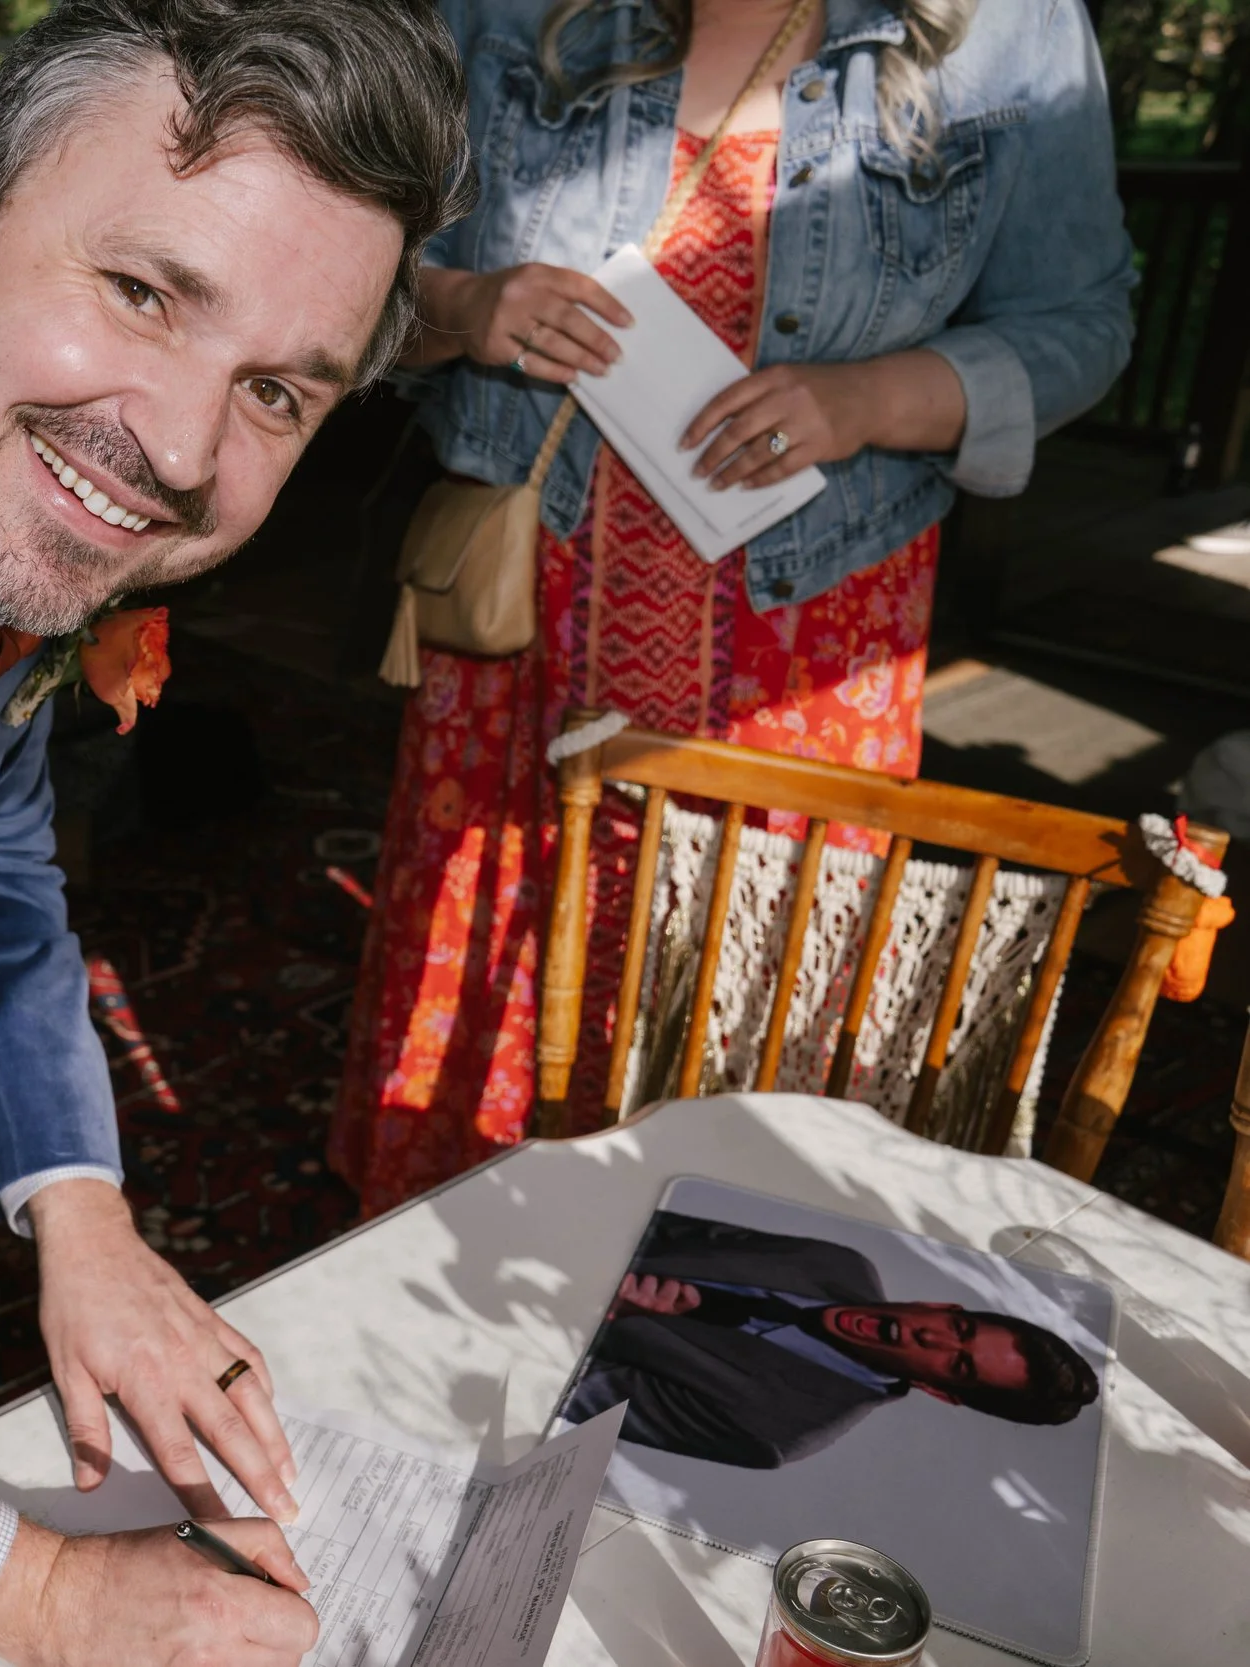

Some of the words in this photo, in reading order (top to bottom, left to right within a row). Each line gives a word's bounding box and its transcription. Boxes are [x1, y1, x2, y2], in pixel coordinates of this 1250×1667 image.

[540, 1520, 564, 1575] CERTIFICATE
[555, 1546, 568, 1572] STATE
[536, 1577, 546, 1591] OF
[517, 1594, 541, 1642] MARRIAGE
